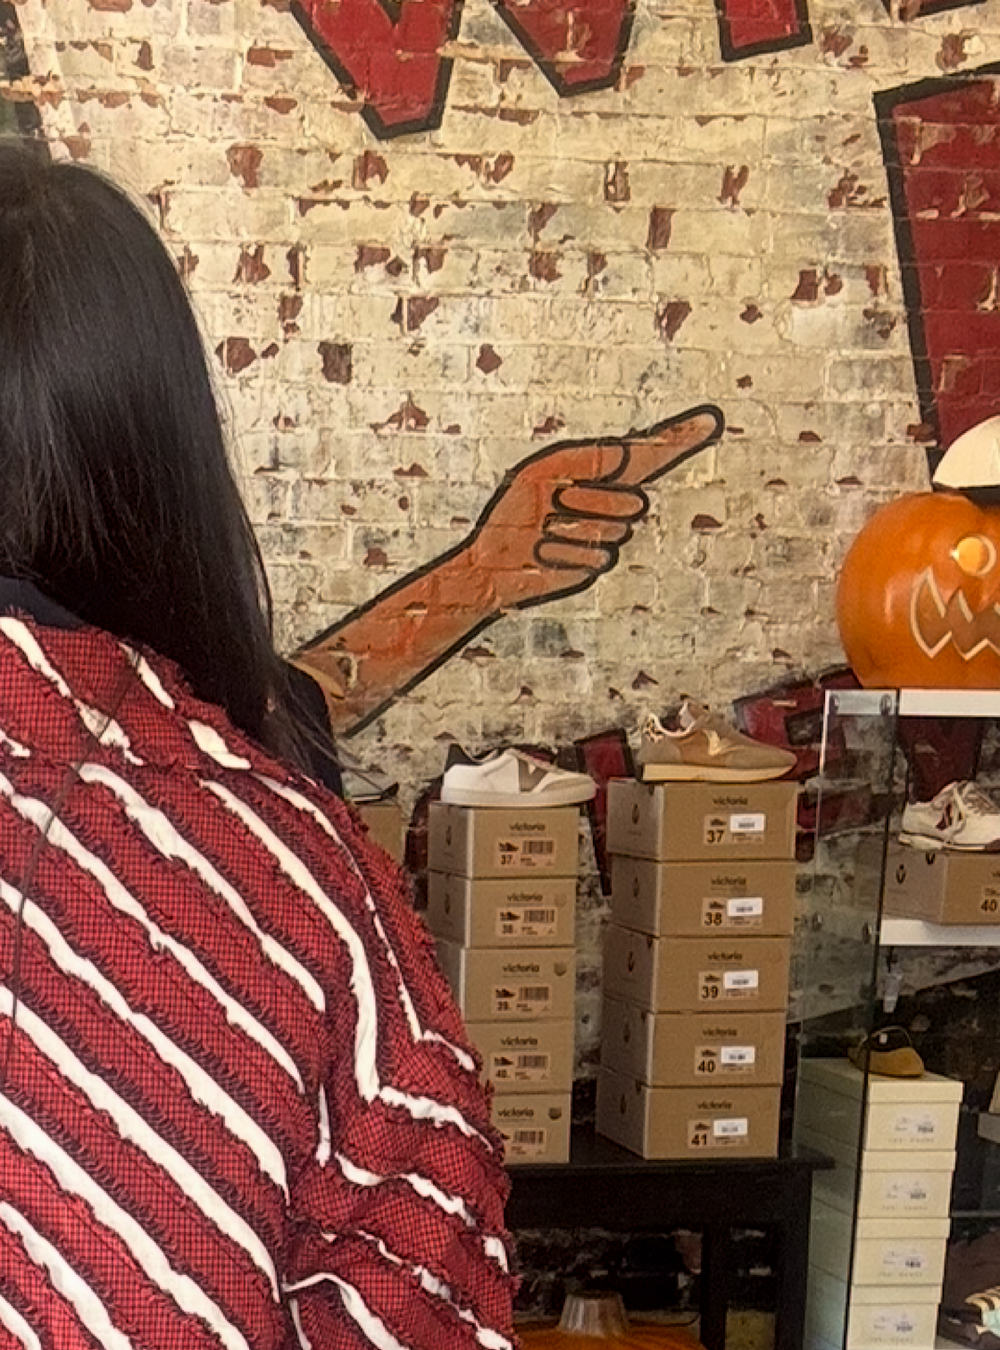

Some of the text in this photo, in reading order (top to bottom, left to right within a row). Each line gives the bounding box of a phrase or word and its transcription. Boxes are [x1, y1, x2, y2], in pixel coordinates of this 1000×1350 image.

[712, 797, 748, 805] victoria
[509, 822, 545, 831] victoria
[707, 830, 725, 843] 37
[711, 877, 747, 886] victoria
[507, 893, 543, 902] victoria
[981, 899, 997, 911] 40
[704, 912, 722, 926] 38
[708, 952, 742, 961] victoria
[502, 963, 540, 972] victoria
[702, 986, 718, 999] 39
[702, 1027, 737, 1036] victoria
[501, 1036, 538, 1045] victoria
[697, 1059, 715, 1073] 40
[697, 1101, 732, 1110] victoria
[498, 1107, 534, 1117] victoria
[691, 1133, 707, 1146] 41
